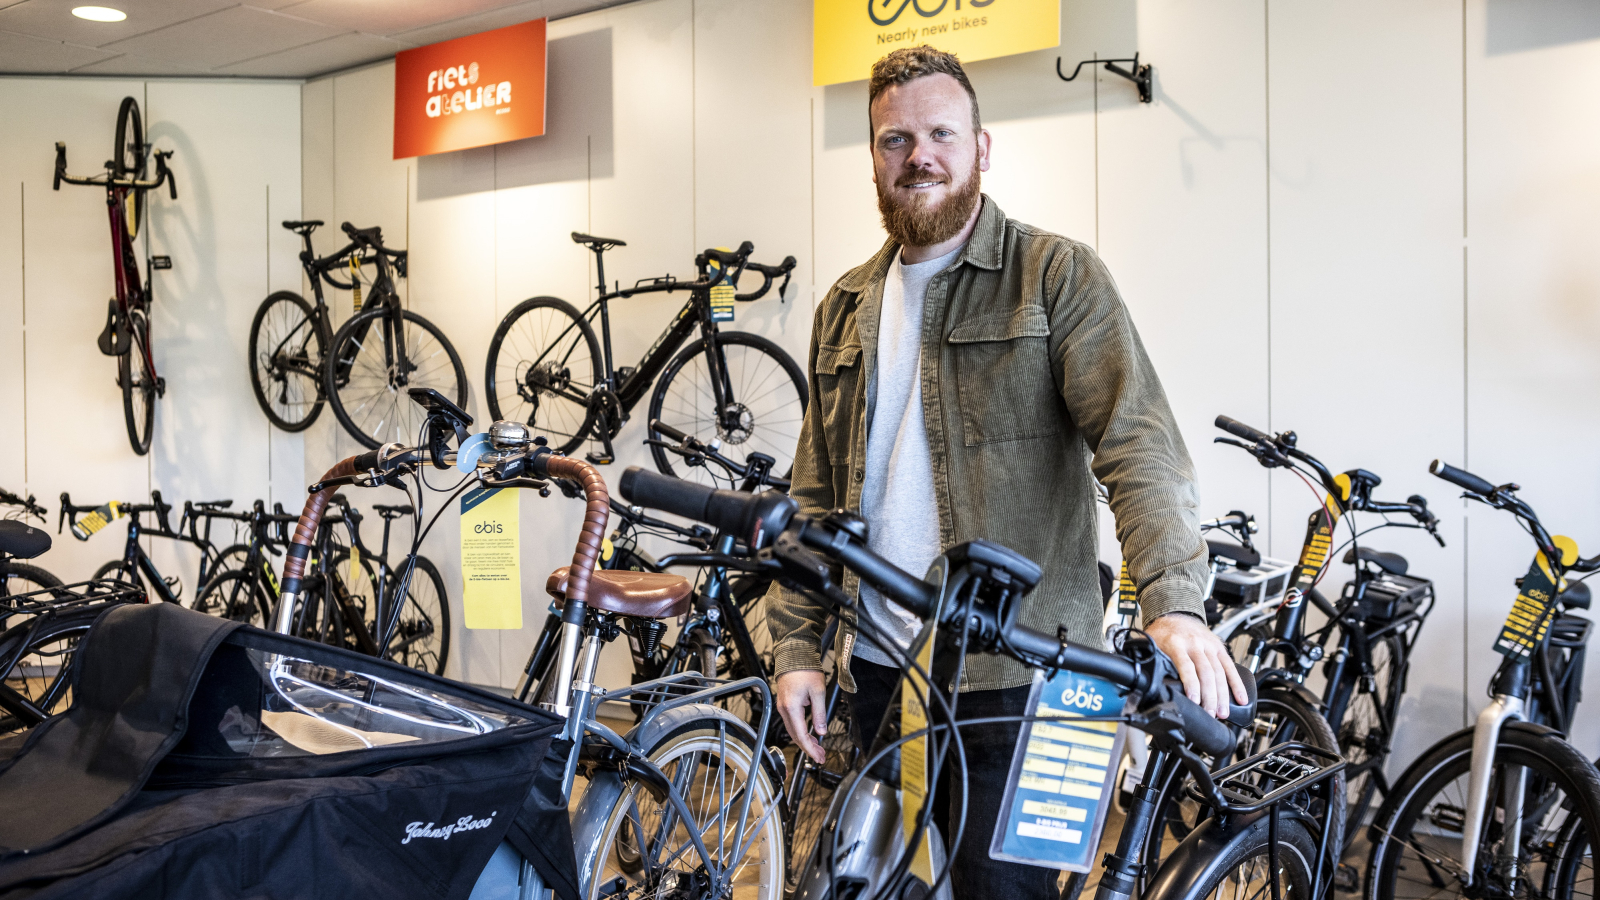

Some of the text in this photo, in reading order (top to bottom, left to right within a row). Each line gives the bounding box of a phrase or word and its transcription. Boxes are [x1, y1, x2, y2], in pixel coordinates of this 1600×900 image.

[877, 16, 988, 44] Nearly new bikes
[474, 520, 503, 534] ebis
[1061, 685, 1104, 711] ebis
[401, 821, 456, 844] Johnny
